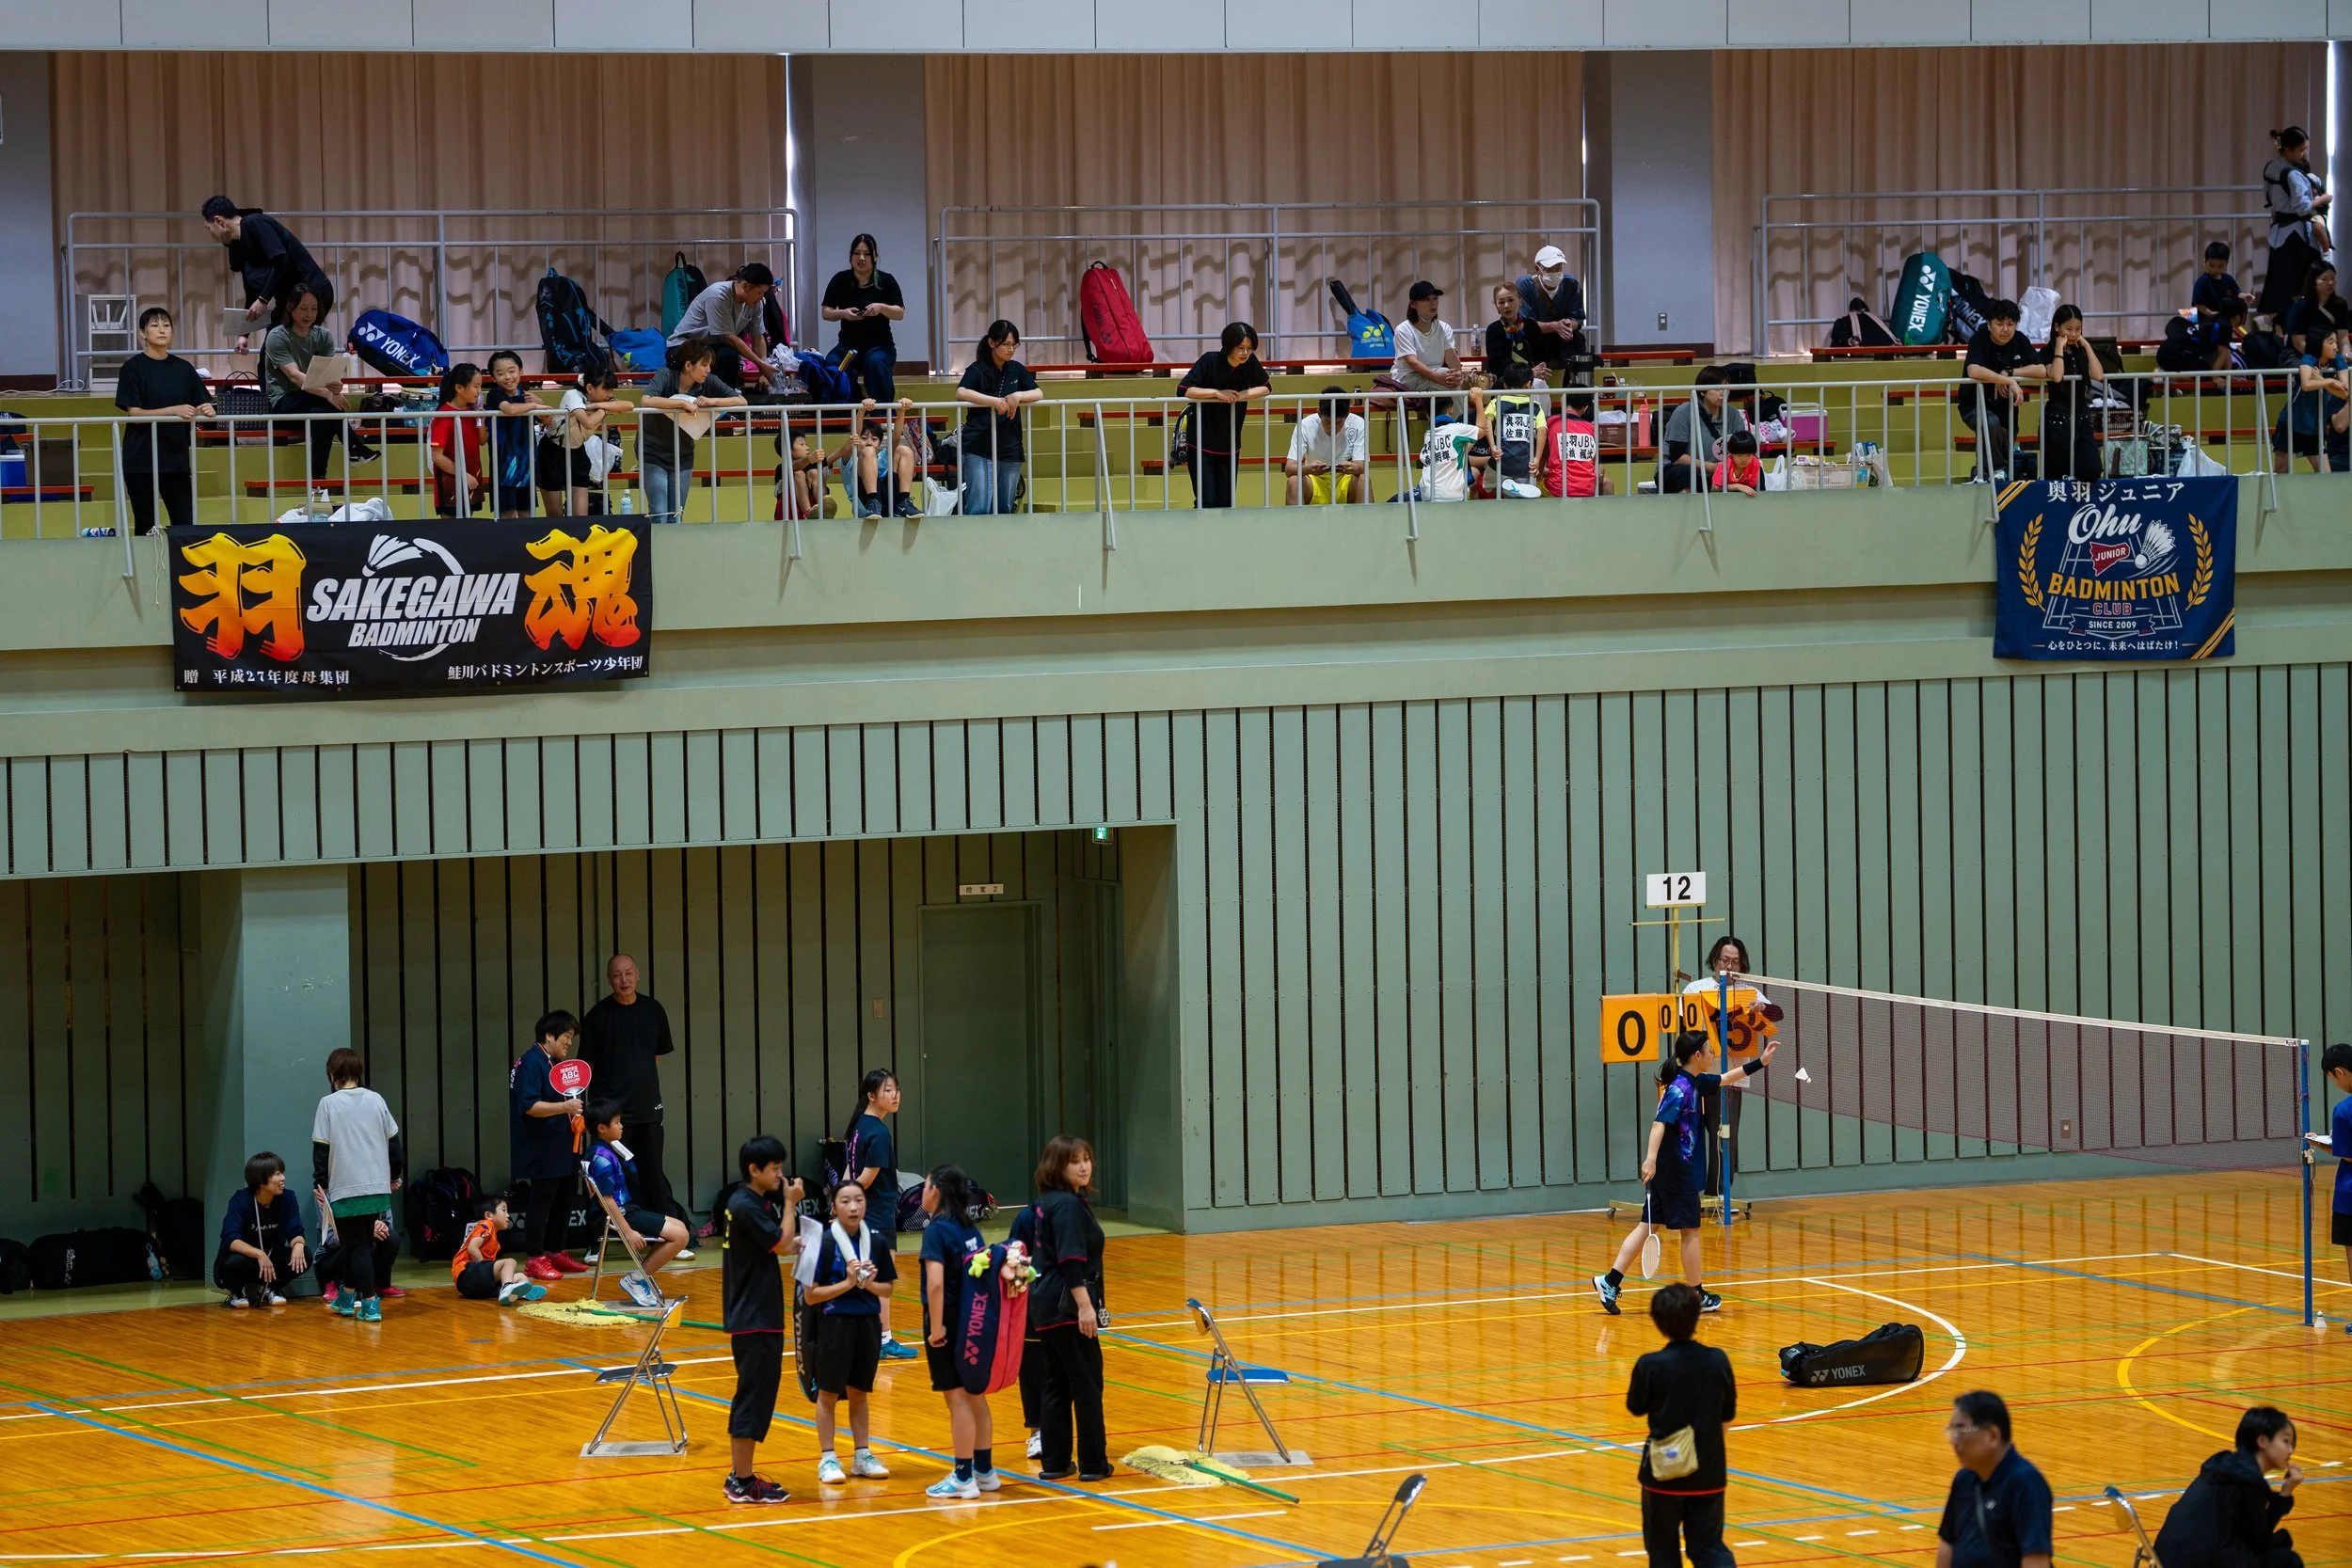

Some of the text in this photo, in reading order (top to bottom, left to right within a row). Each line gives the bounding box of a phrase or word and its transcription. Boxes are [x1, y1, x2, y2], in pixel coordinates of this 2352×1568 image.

[1908, 293, 1931, 333] YONEX
[380, 336, 421, 369] YONEX
[2046, 480, 2185, 503] 奥羽ジュニア
[2068, 503, 2143, 545] Ohu
[2094, 547, 2126, 562] JUNIOR
[178, 531, 308, 662] 羽
[306, 572, 520, 623] SAKEGAWA
[524, 524, 642, 651] 魂
[2046, 571, 2181, 601] BADMINTON
[2092, 602, 2133, 616] CLUB
[347, 617, 482, 648] BADMINTON
[2088, 620, 2137, 630] SINCE 2009
[213, 668, 350, 686] 平成27年度母集団
[447, 656, 644, 681] 鮭川バドミントンスポーツ少年団
[1662, 876, 1692, 901] 12
[1617, 1010, 1646, 1056] 0
[1661, 1004, 1672, 1030] 0
[1687, 1003, 1697, 1028] 0
[562, 1069, 580, 1081] ABC
[771, 1197, 819, 1220] YNEX
[966, 1292, 989, 1338] YONEX
[795, 1310, 806, 1375] YONEX
[1831, 1364, 1867, 1381] YONEX
